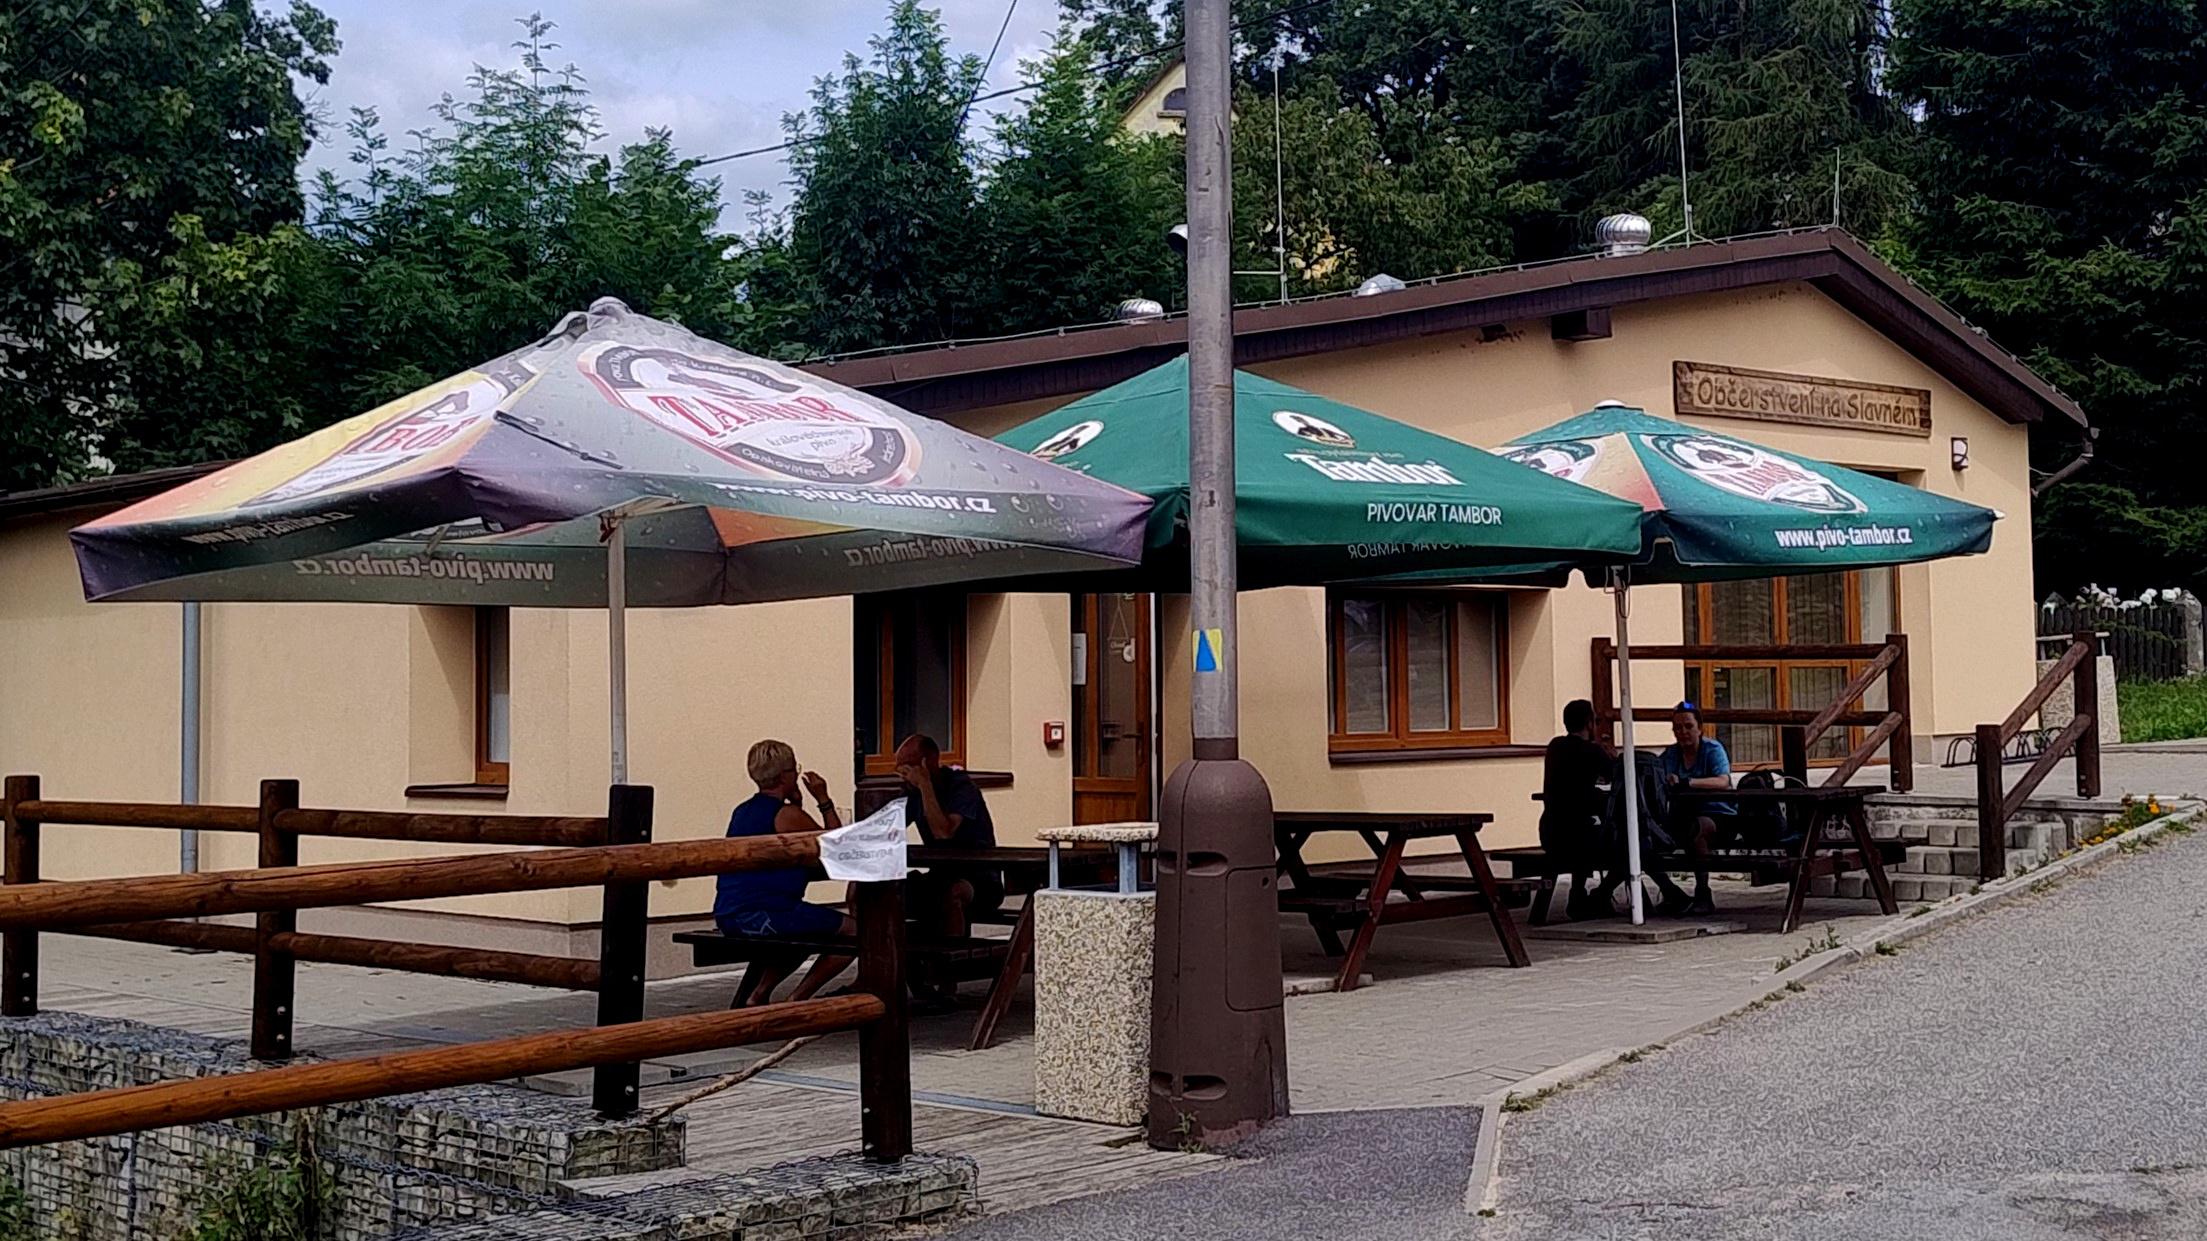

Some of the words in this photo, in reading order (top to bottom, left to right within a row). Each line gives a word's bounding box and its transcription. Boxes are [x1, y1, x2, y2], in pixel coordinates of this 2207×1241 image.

[647, 395, 872, 436] TAMBOR
[1698, 376, 1816, 413] Občerstvení
[1821, 396, 1842, 418] na
[1847, 392, 1917, 426] Slavném
[1367, 503, 1437, 523] PIVOVAR
[1441, 504, 1502, 525] TAMBOR
[1775, 525, 1912, 551] www.pivo-tambor.cz
